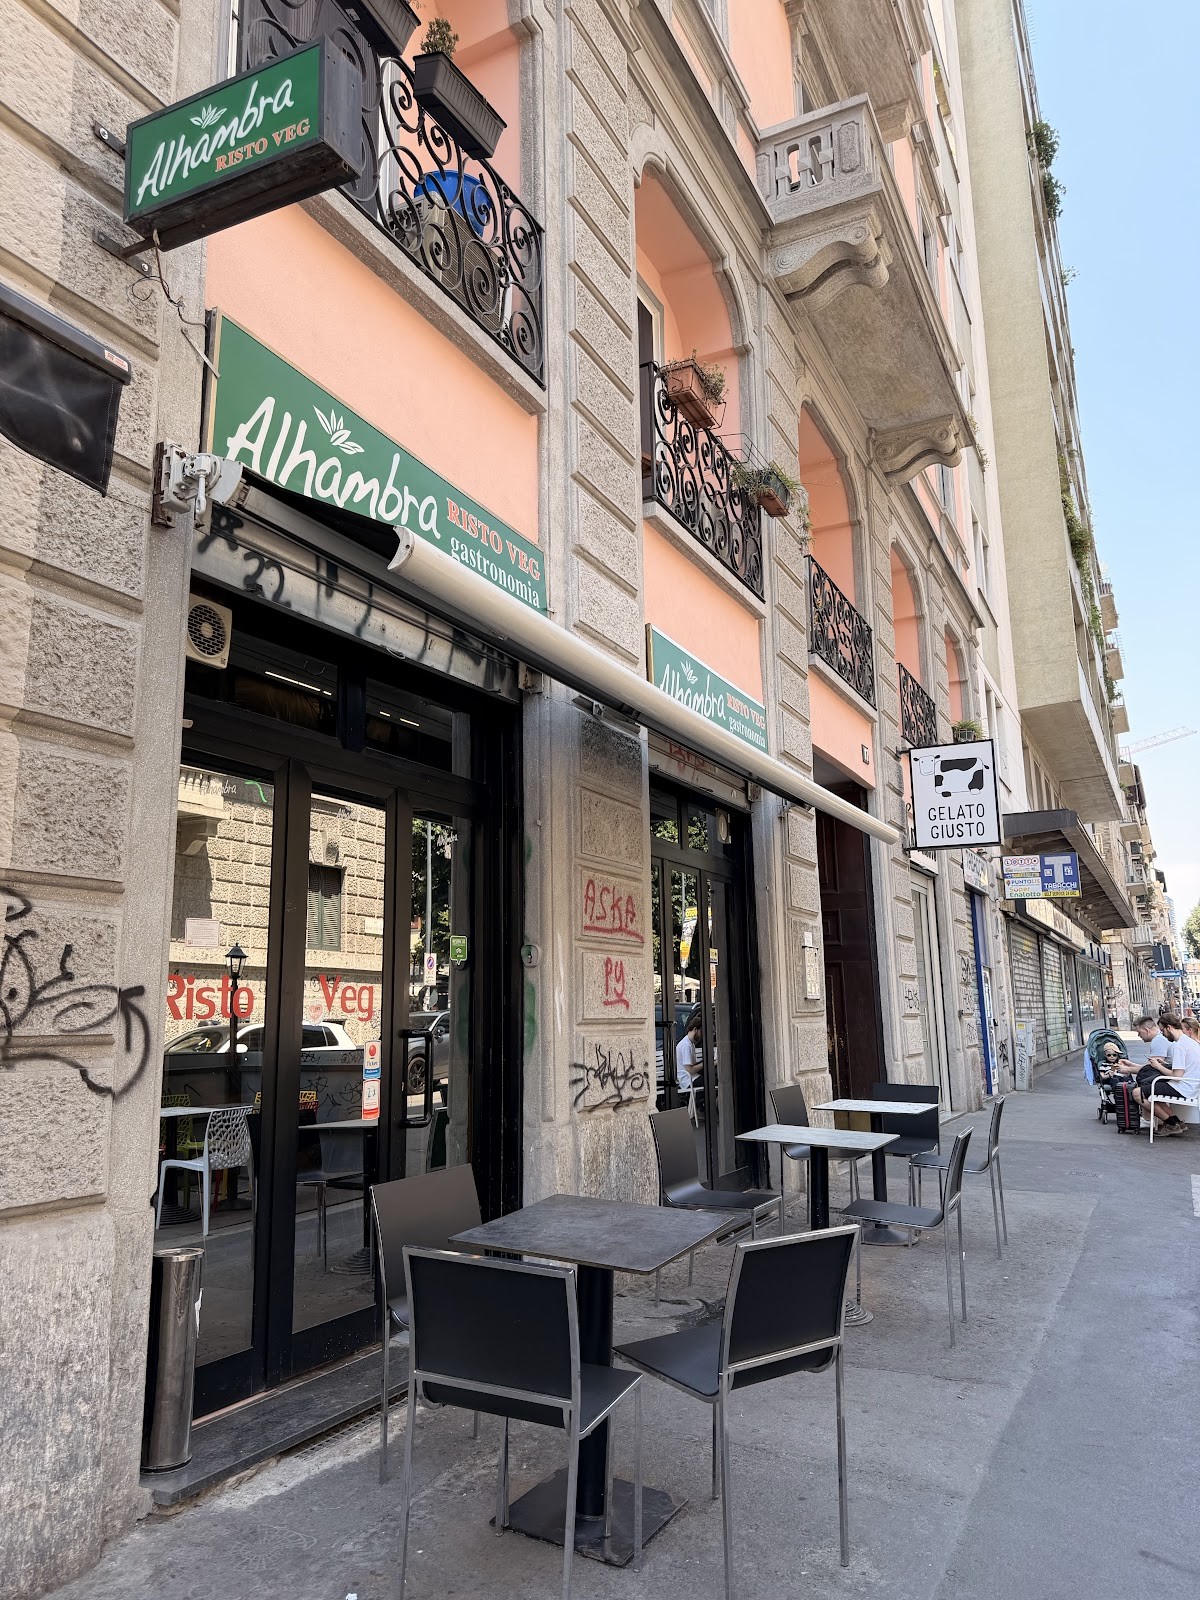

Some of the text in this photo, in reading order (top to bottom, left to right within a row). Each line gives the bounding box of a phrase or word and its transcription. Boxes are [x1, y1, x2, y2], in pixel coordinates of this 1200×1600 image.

[136, 78, 295, 206] Alhambra
[214, 118, 311, 173] RISTO VEG
[226, 396, 441, 540] Alhambra
[446, 497, 541, 581] RISTO VEG
[450, 536, 540, 609] gastronomia
[660, 663, 726, 721] Alhambra
[726, 692, 766, 731] RISTO VEG
[729, 716, 766, 749] gastronomia
[928, 803, 985, 821] GELATO
[930, 821, 985, 839] GIUSTO
[1004, 857, 1039, 866] LOTTO
[1044, 856, 1072, 883] T
[1043, 882, 1077, 890] TABACCHI
[166, 974, 374, 1022] Risto Veg
